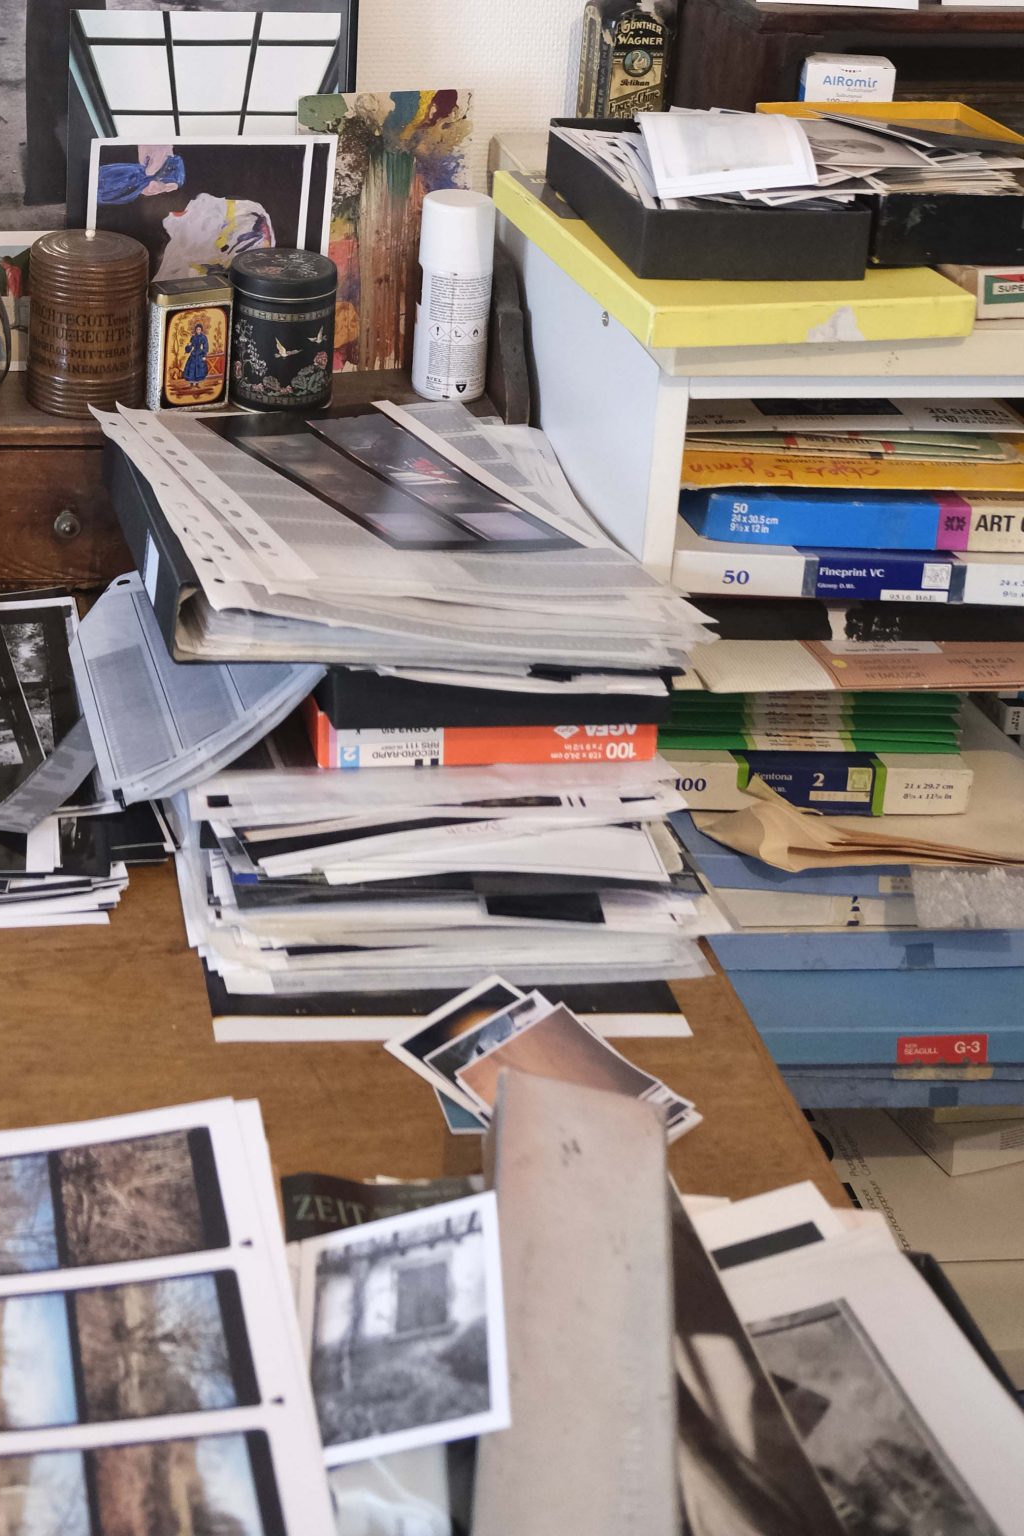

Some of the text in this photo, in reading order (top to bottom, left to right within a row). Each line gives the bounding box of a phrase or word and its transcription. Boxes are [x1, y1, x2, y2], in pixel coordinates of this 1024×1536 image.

[617, 31, 663, 45] WAGNER
[732, 503, 749, 514] 50
[766, 516, 779, 525] cm
[974, 514, 1016, 532] ART
[722, 570, 750, 585] 50
[819, 566, 886, 579] Fineprint VC
[343, 747, 358, 762] 2
[371, 749, 440, 760] RECORD-RAPID
[605, 742, 638, 760] 100
[675, 776, 707, 793] 100
[755, 771, 826, 788] entona 2
[954, 1040, 981, 1054] G-3
[292, 1193, 365, 1225] ZEIT
